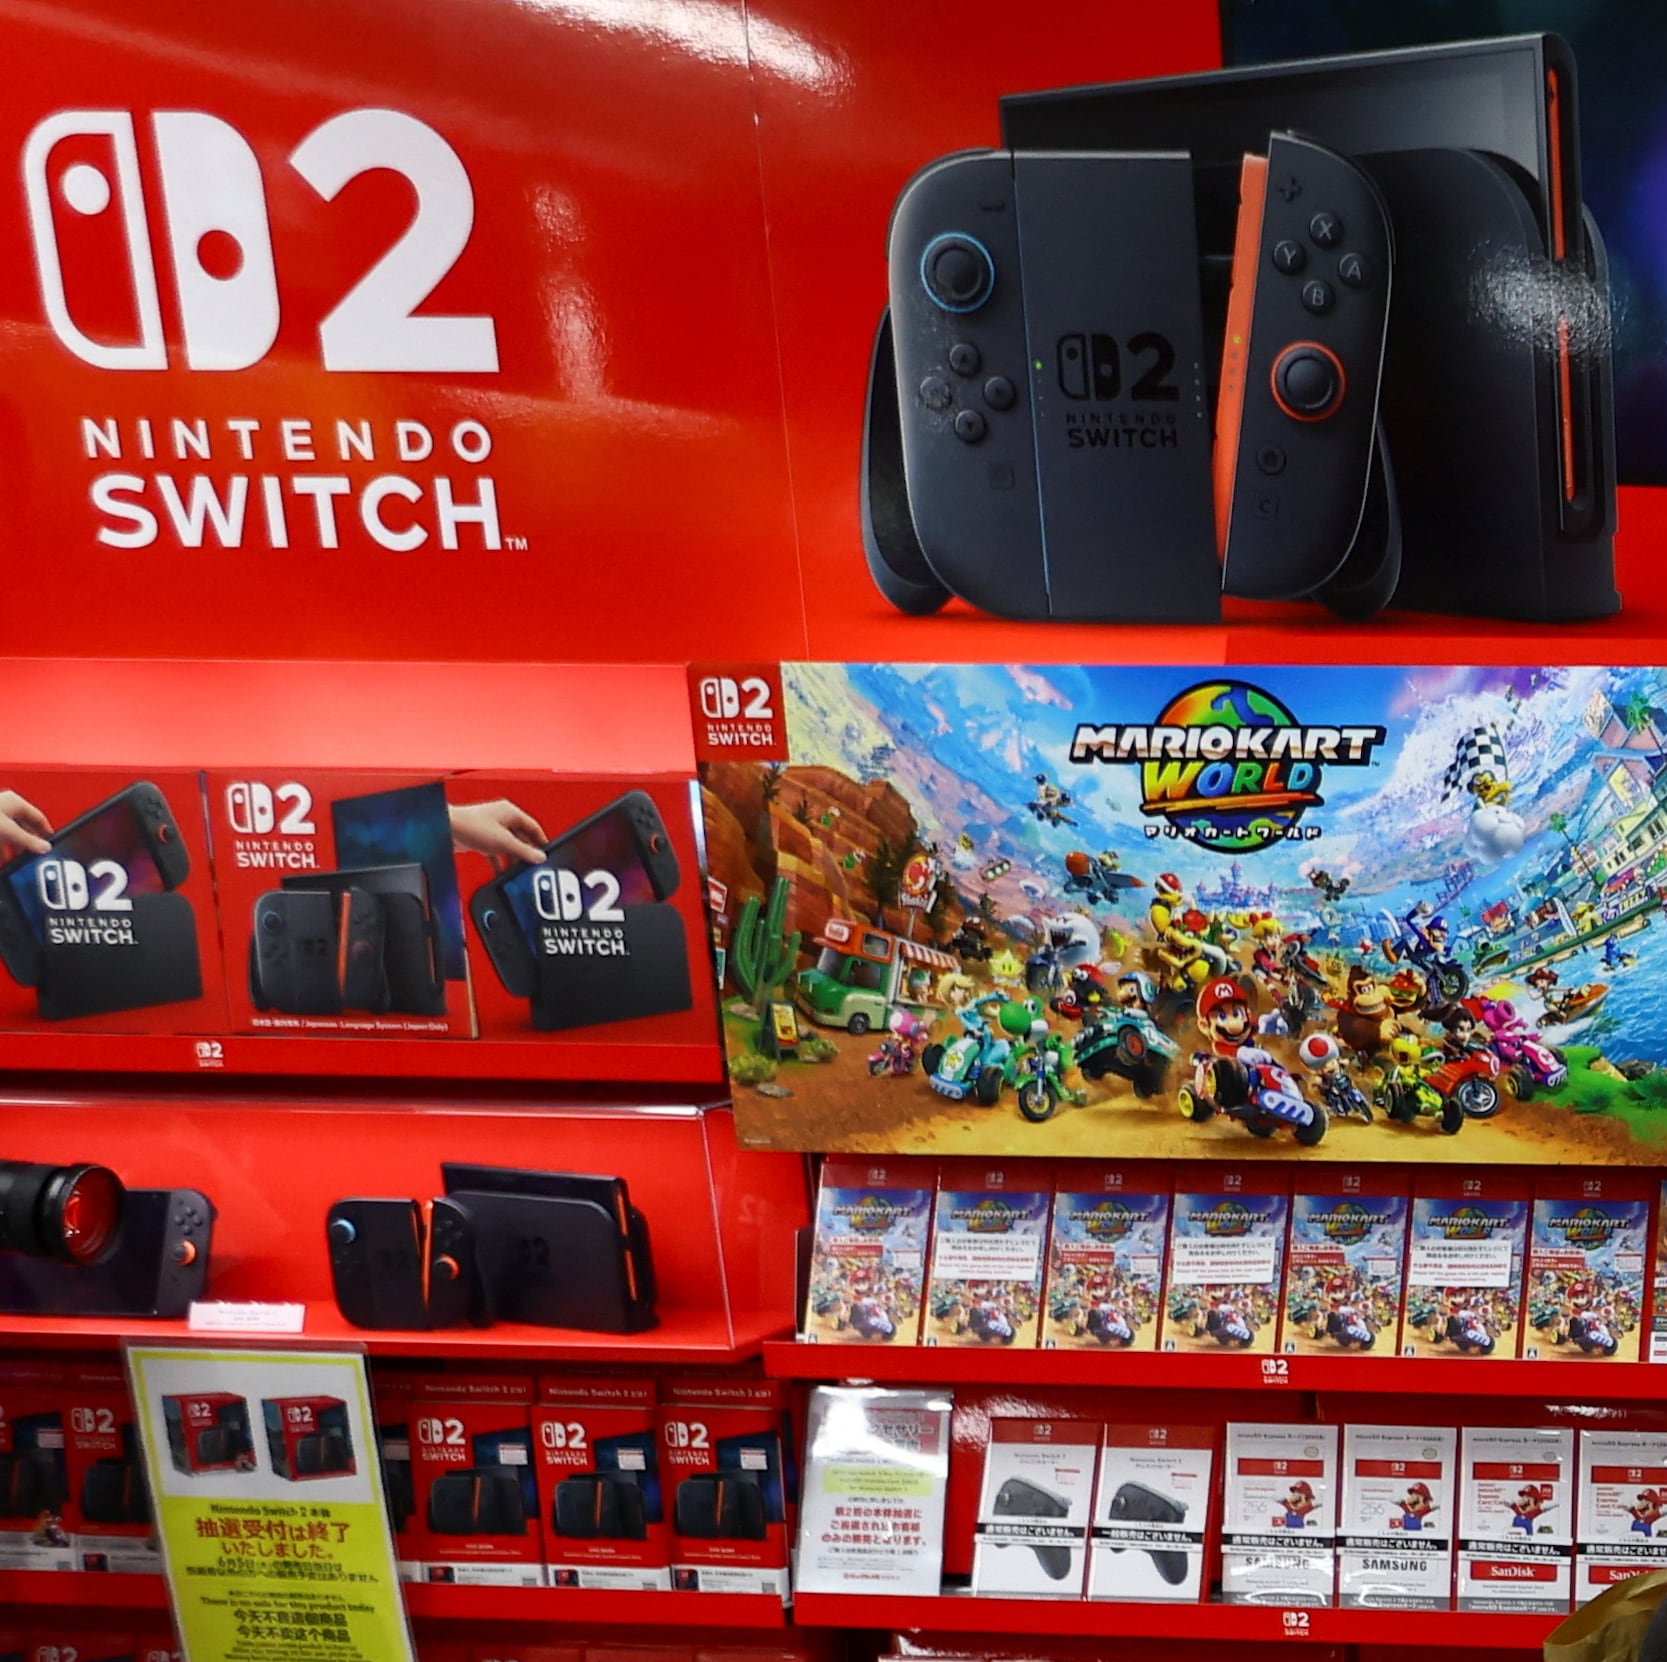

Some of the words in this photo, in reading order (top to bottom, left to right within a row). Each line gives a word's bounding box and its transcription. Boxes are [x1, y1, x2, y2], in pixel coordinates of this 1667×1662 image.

[287, 107, 499, 372] 2
[1126, 331, 1179, 401] 2
[1066, 413, 1177, 425] NINTENDO
[82, 418, 491, 462] NINTENDO
[1067, 427, 1178, 448] SWITCH
[90, 473, 501, 551] SWITCH
[742, 678, 772, 718] 2
[708, 730, 772, 745] SWITCH
[1141, 760, 1319, 798] WORLD
[276, 782, 315, 834] 2
[236, 841, 313, 851] NINTENDO
[236, 851, 315, 868] SWITCH
[89, 862, 133, 911] 2
[585, 871, 625, 921] 2
[49, 918, 132, 928] NINTENDO
[50, 928, 135, 944] SWITCH
[544, 928, 624, 938] NINTENDO
[545, 939, 626, 956] SWITCH
[196, 1517, 351, 1543] 抽選受付は終了
[221, 1541, 334, 1559] いたしました。
[1362, 1558, 1428, 1572] SAMSUNG
[1490, 1566, 1536, 1577] SanDisk
